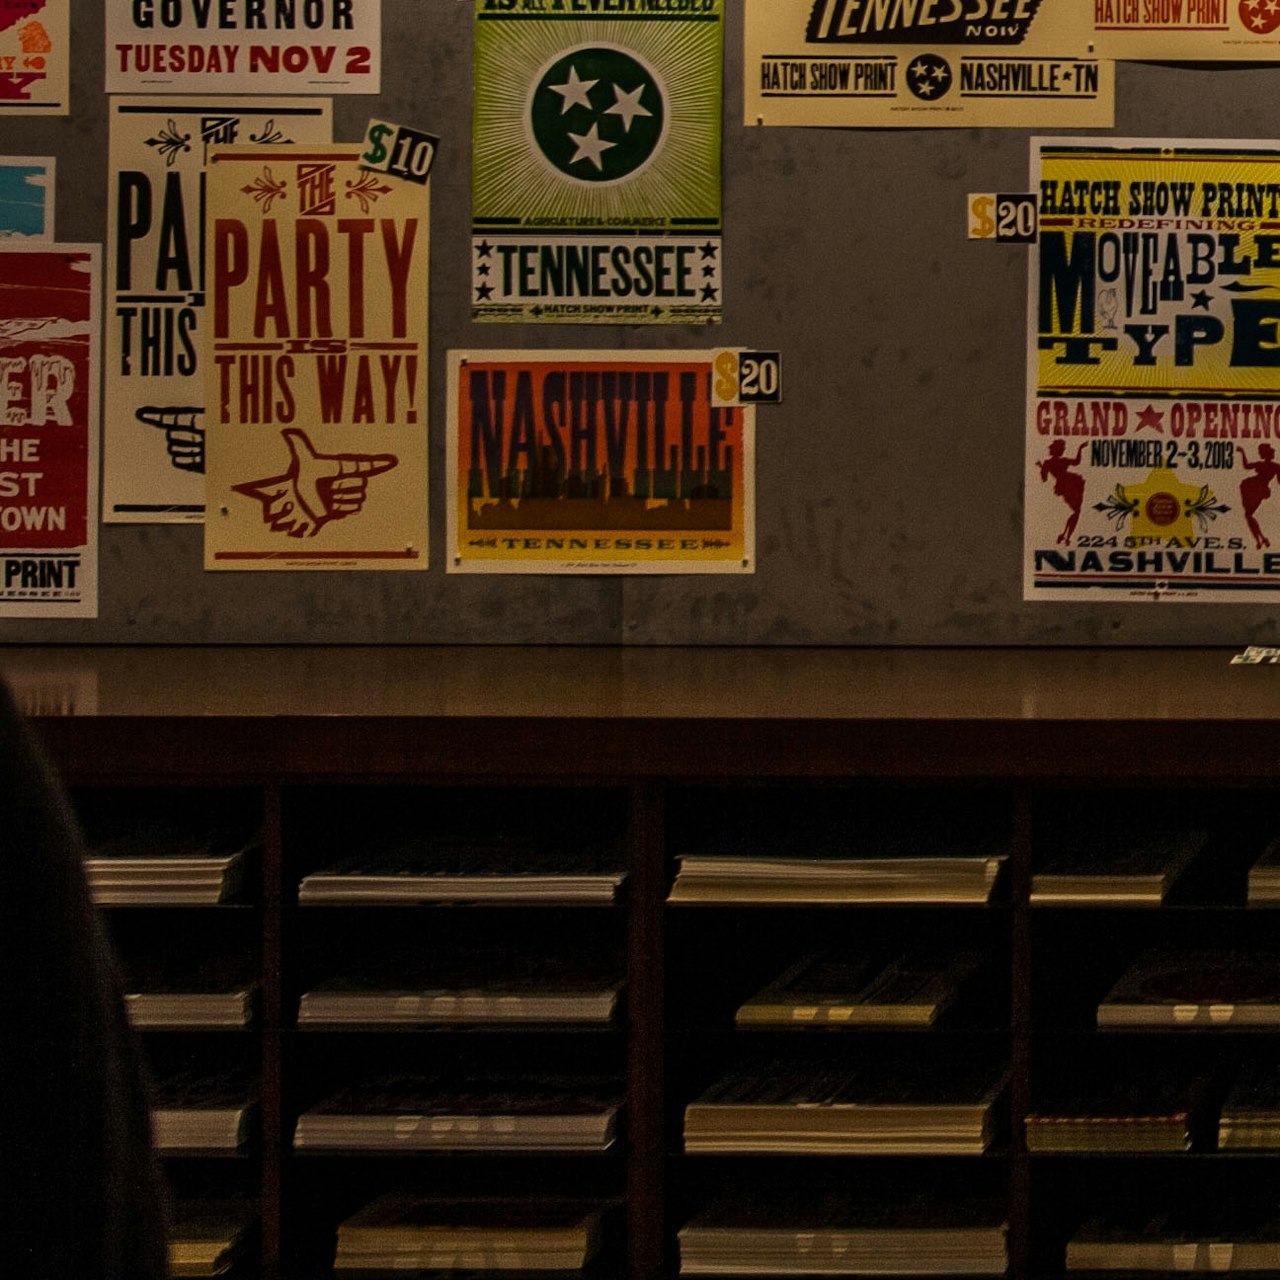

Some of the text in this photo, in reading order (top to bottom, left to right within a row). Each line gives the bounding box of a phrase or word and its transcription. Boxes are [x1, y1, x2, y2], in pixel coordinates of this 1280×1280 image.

[116, 44, 371, 74] TUESDAY NOV 2
[215, 219, 419, 338] PARTY
[498, 244, 697, 299] TENNESSEE
[215, 354, 419, 424] THIS WAY!
[1037, 401, 1128, 437] GRAND
